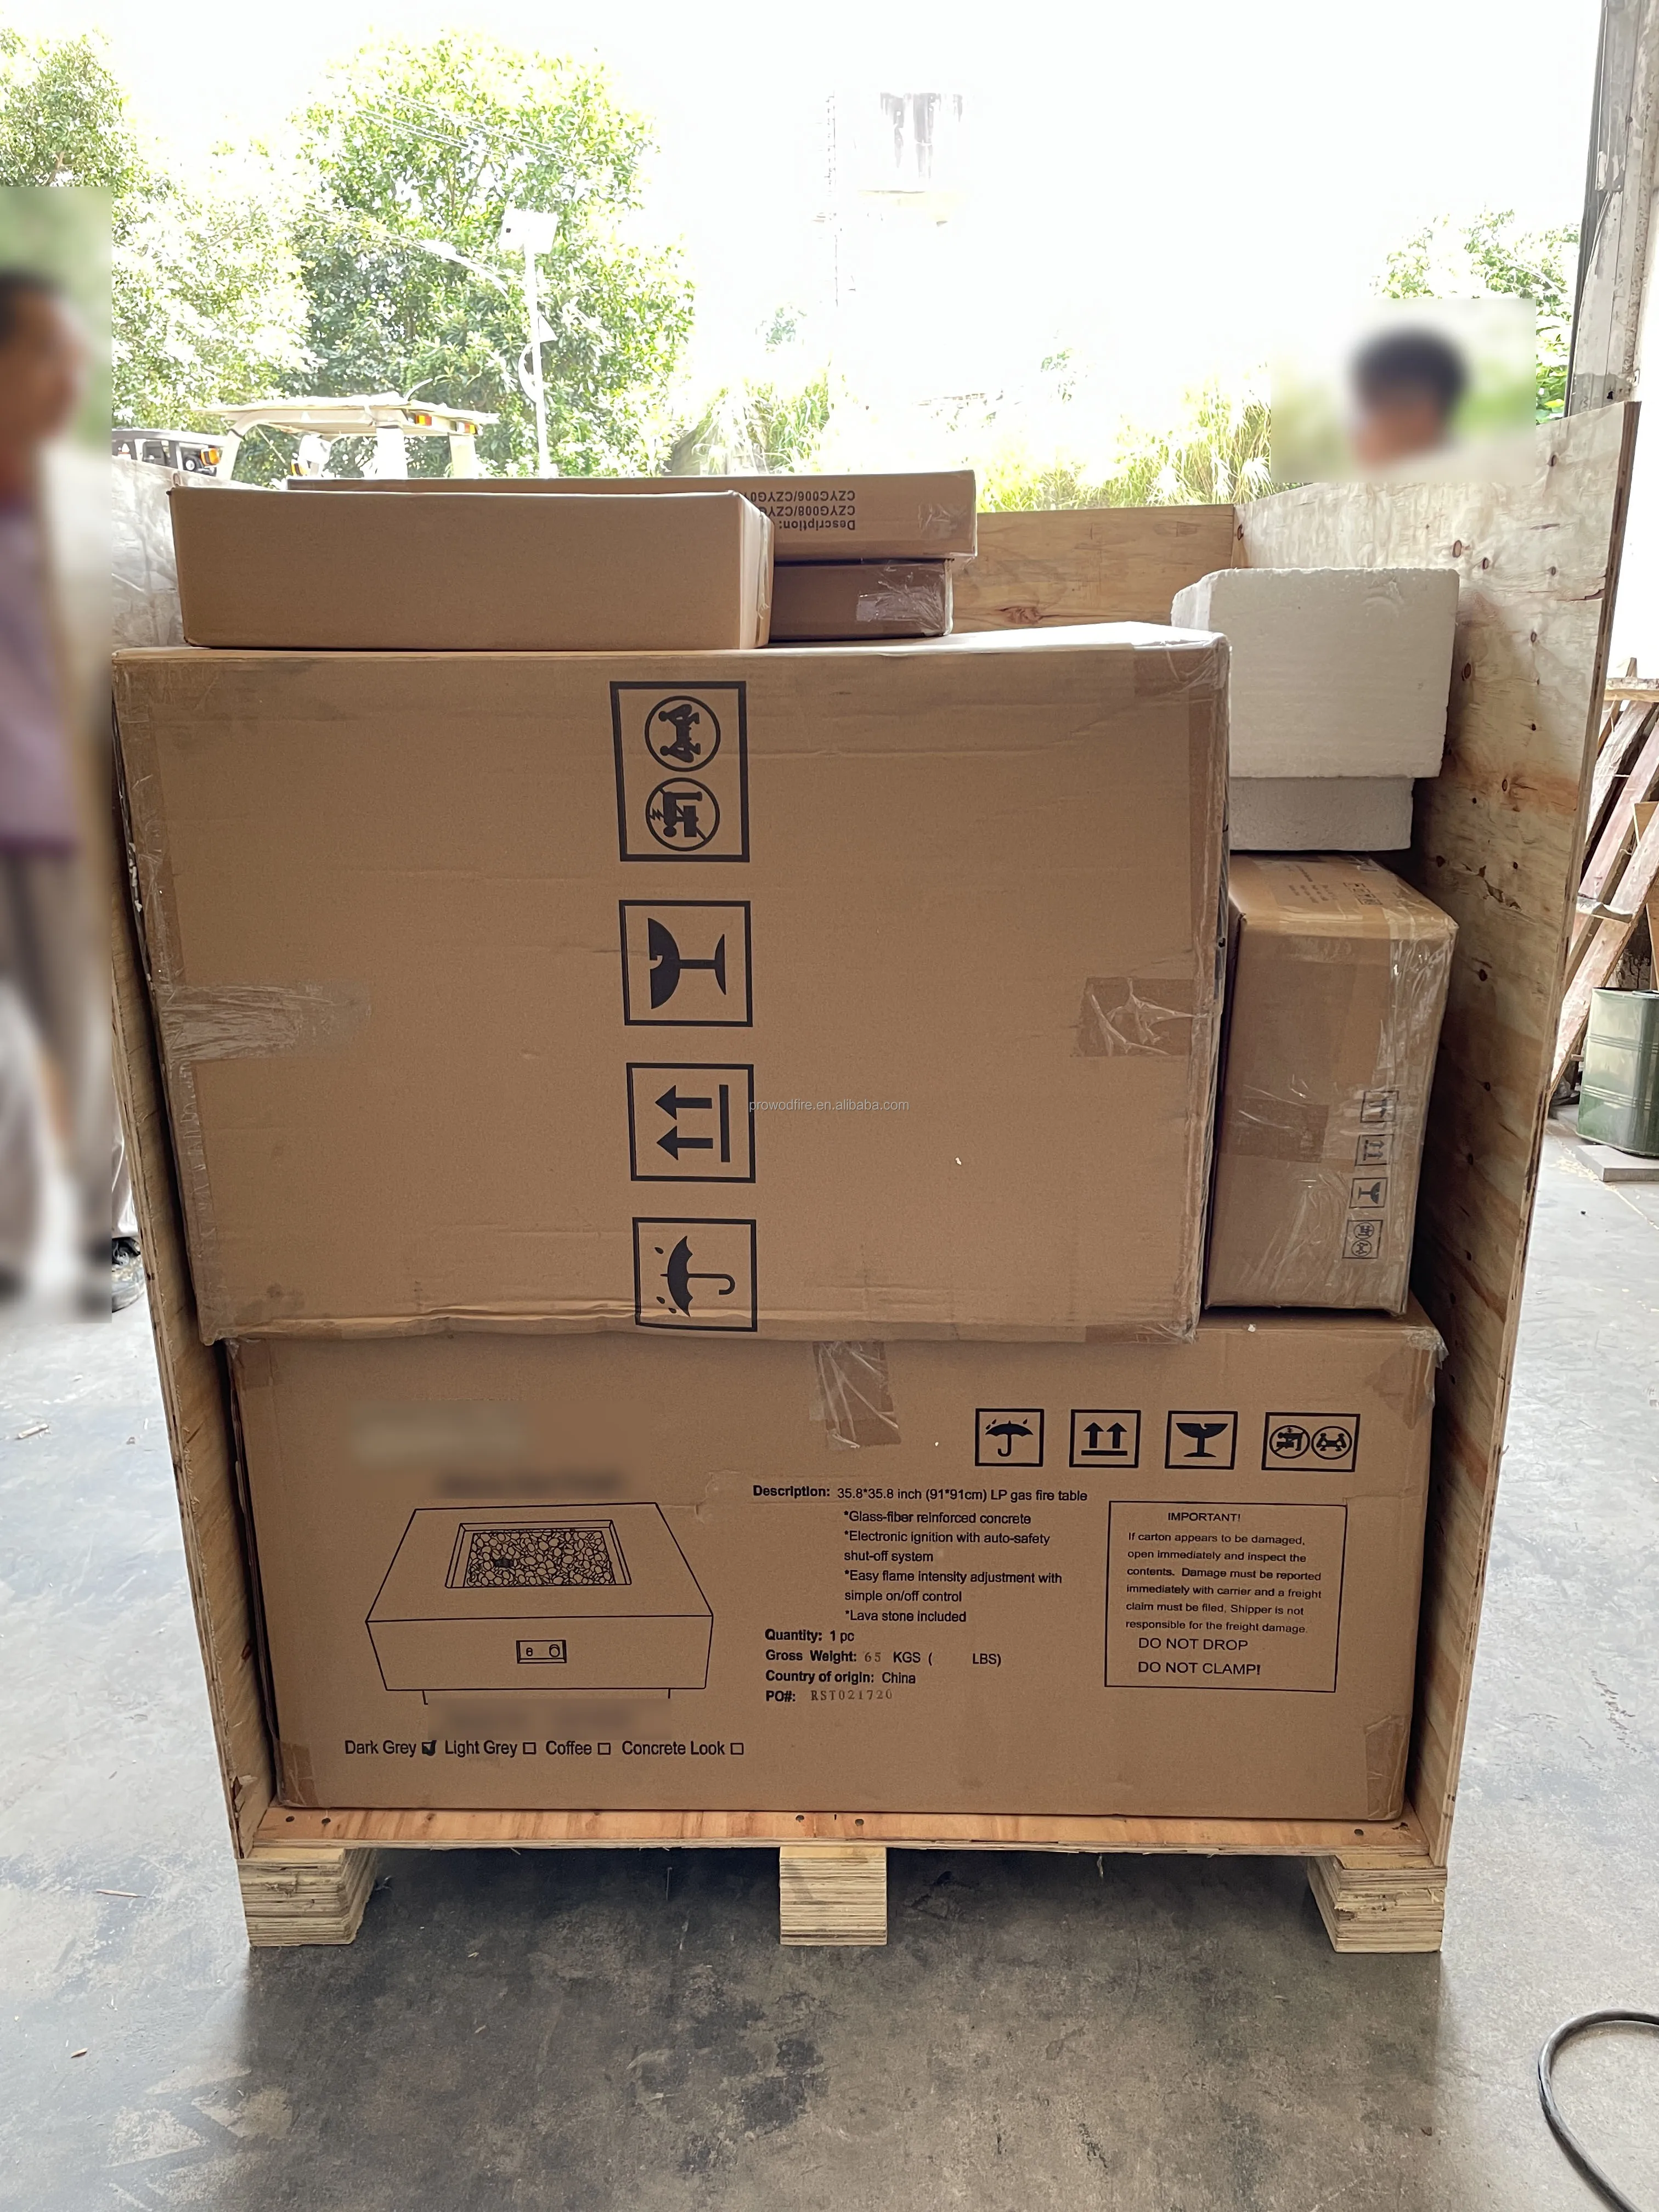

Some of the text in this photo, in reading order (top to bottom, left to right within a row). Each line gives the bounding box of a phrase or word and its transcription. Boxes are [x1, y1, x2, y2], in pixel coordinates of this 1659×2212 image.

[743, 490, 856, 502] CZYG006/CZYG0
[780, 518, 855, 531] Description:
[753, 1485, 830, 1499] Description:
[898, 1488, 922, 1499] inch
[991, 1489, 1008, 1500] LP
[1010, 1492, 1032, 1503] gas
[1035, 1489, 1055, 1501] fire
[1058, 1489, 1088, 1501] table
[916, 1511, 977, 1523] reinforced
[979, 1513, 1031, 1525] concrete
[1168, 1512, 1240, 1522] IMPORTANT!
[911, 1531, 953, 1545] ignition
[956, 1532, 980, 1543] with
[984, 1532, 1051, 1547] auto-safety
[1128, 1532, 1305, 1546] If carton appears to be damaged,
[844, 1550, 934, 1565] shut-off system
[1127, 1550, 1306, 1563] open immediately and inspect the
[882, 1570, 915, 1582] flame
[918, 1570, 967, 1585] intensity
[970, 1571, 1035, 1585] adjustment
[1038, 1572, 1062, 1584] with
[1127, 1567, 1322, 1582] contents. Damage must be reported
[844, 1590, 962, 1604] simple on/off control
[1126, 1584, 1190, 1596] immediately
[1192, 1585, 1214, 1594] with
[1217, 1587, 1252, 1595] carrier
[1254, 1588, 1275, 1596] and
[1288, 1588, 1322, 1600] freight
[882, 1610, 914, 1622] stone
[917, 1610, 967, 1622] included
[1126, 1602, 1154, 1611] claim
[1156, 1603, 1183, 1611] must
[1186, 1602, 1199, 1612] be
[1231, 1604, 1273, 1615] Shipper
[1275, 1606, 1284, 1615] is
[1287, 1607, 1304, 1616] not
[1126, 1620, 1308, 1635] responsible for the freight damage.
[765, 1628, 855, 1644] Quantity: 1 pc
[1138, 1637, 1248, 1651] DO NOT DROP
[765, 1649, 803, 1661] Gross
[809, 1650, 857, 1664] Weight:
[864, 1652, 881, 1662] 65
[893, 1651, 921, 1663] KGS
[972, 1653, 1002, 1668] LBS)
[1138, 1661, 1261, 1675] DO NOT CLAMP!
[765, 1669, 916, 1685] Country of origin: China
[766, 1689, 892, 1702] PO#: RST021720
[345, 1740, 726, 1758] Dark Grey Light Grey Coffee Concrete Look
